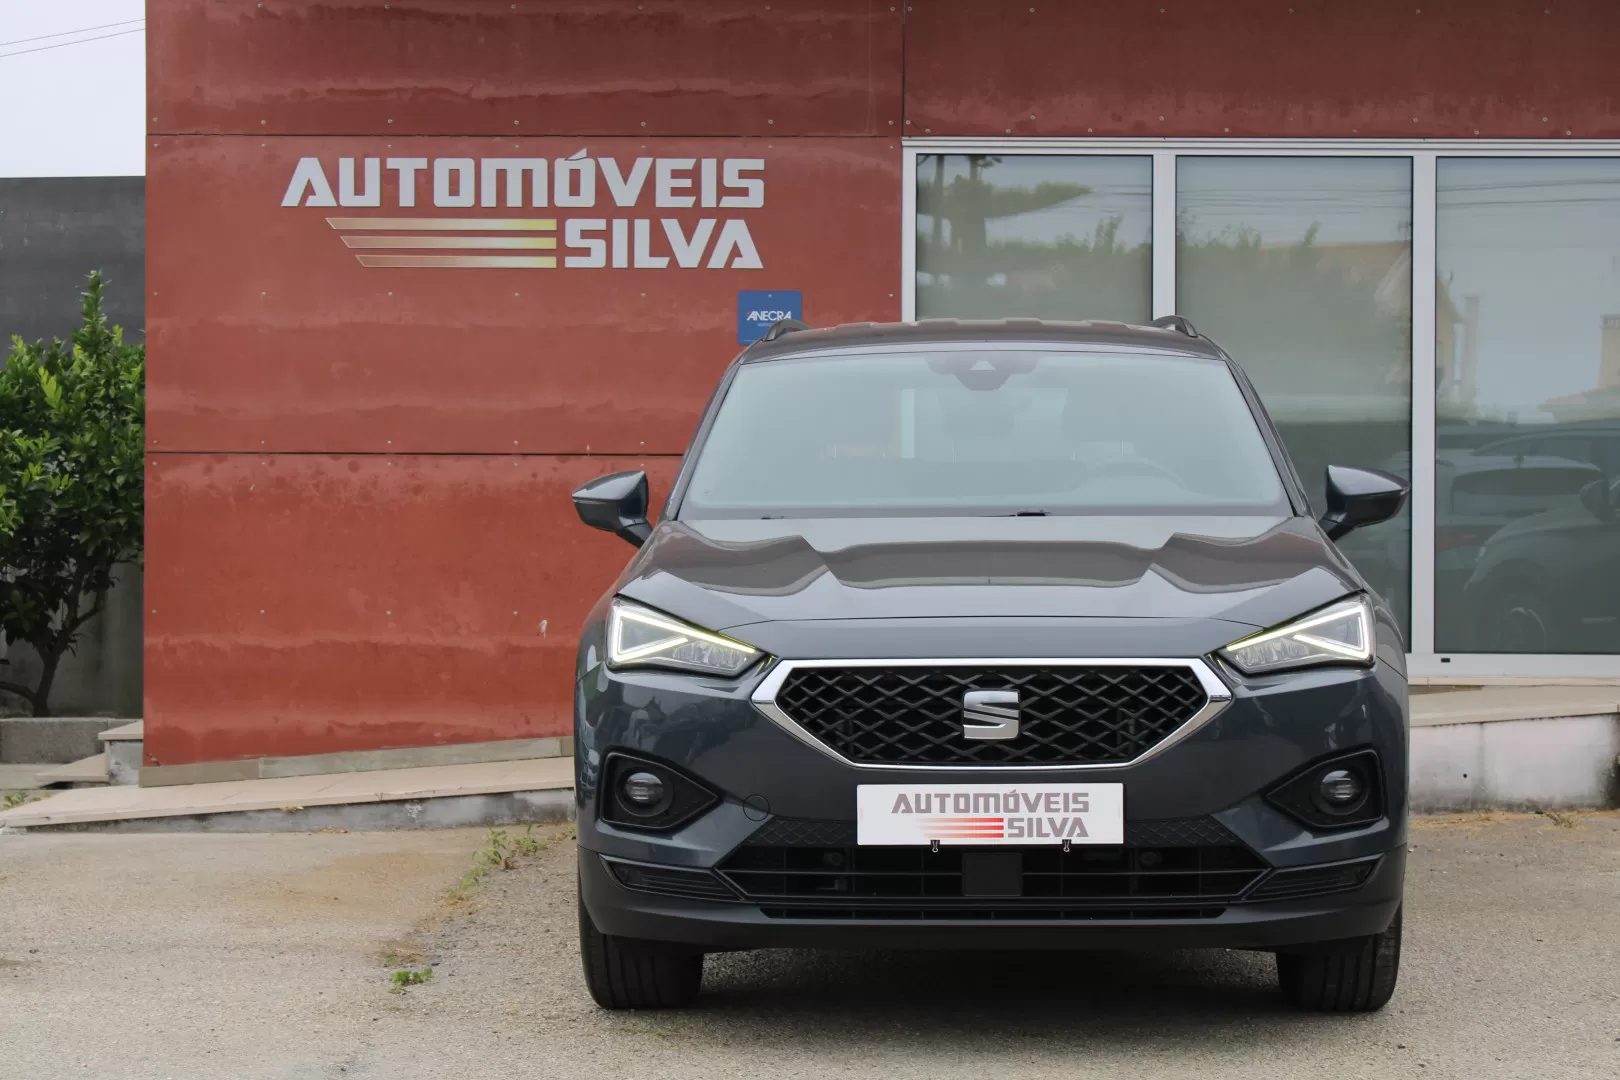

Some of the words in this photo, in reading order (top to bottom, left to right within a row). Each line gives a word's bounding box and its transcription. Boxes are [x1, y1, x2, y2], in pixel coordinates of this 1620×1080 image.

[281, 148, 765, 208] AUTOMÓVEIS
[564, 219, 764, 269] SILVA
[746, 310, 792, 321] ANECRA
[891, 788, 1089, 813] AUTOMÓVEIS
[1007, 817, 1089, 838] SILVA
